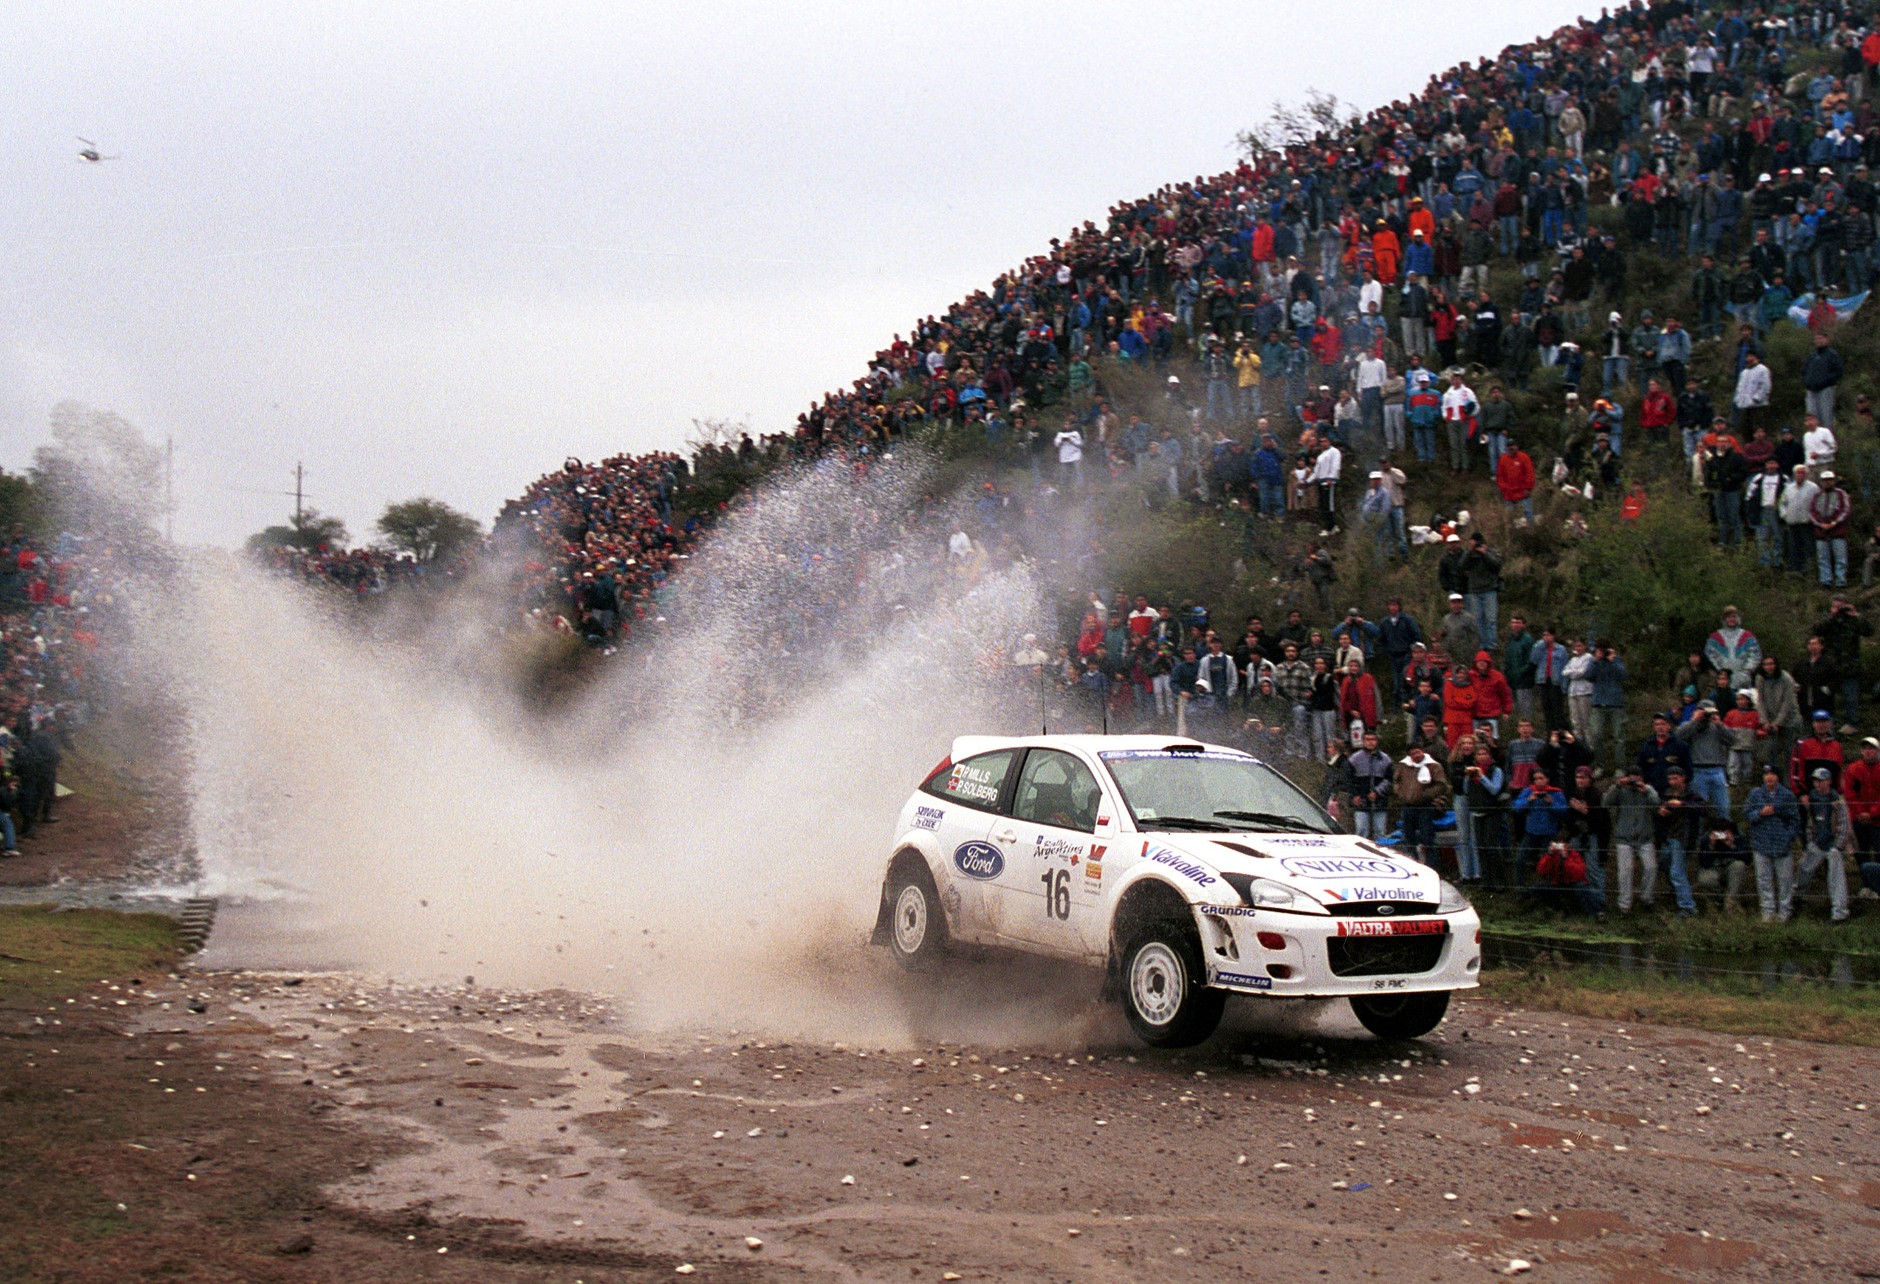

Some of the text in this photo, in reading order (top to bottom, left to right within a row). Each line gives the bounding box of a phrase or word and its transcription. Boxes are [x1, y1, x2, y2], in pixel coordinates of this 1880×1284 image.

[963, 846, 995, 874] Ford
[1152, 848, 1216, 888] Valvoline
[1295, 861, 1397, 874] NIKKO
[1041, 867, 1071, 921] 16
[1354, 887, 1424, 900] Valvoline
[1200, 904, 1256, 917] GRUNDIG
[1218, 973, 1270, 987] MICHELIN
